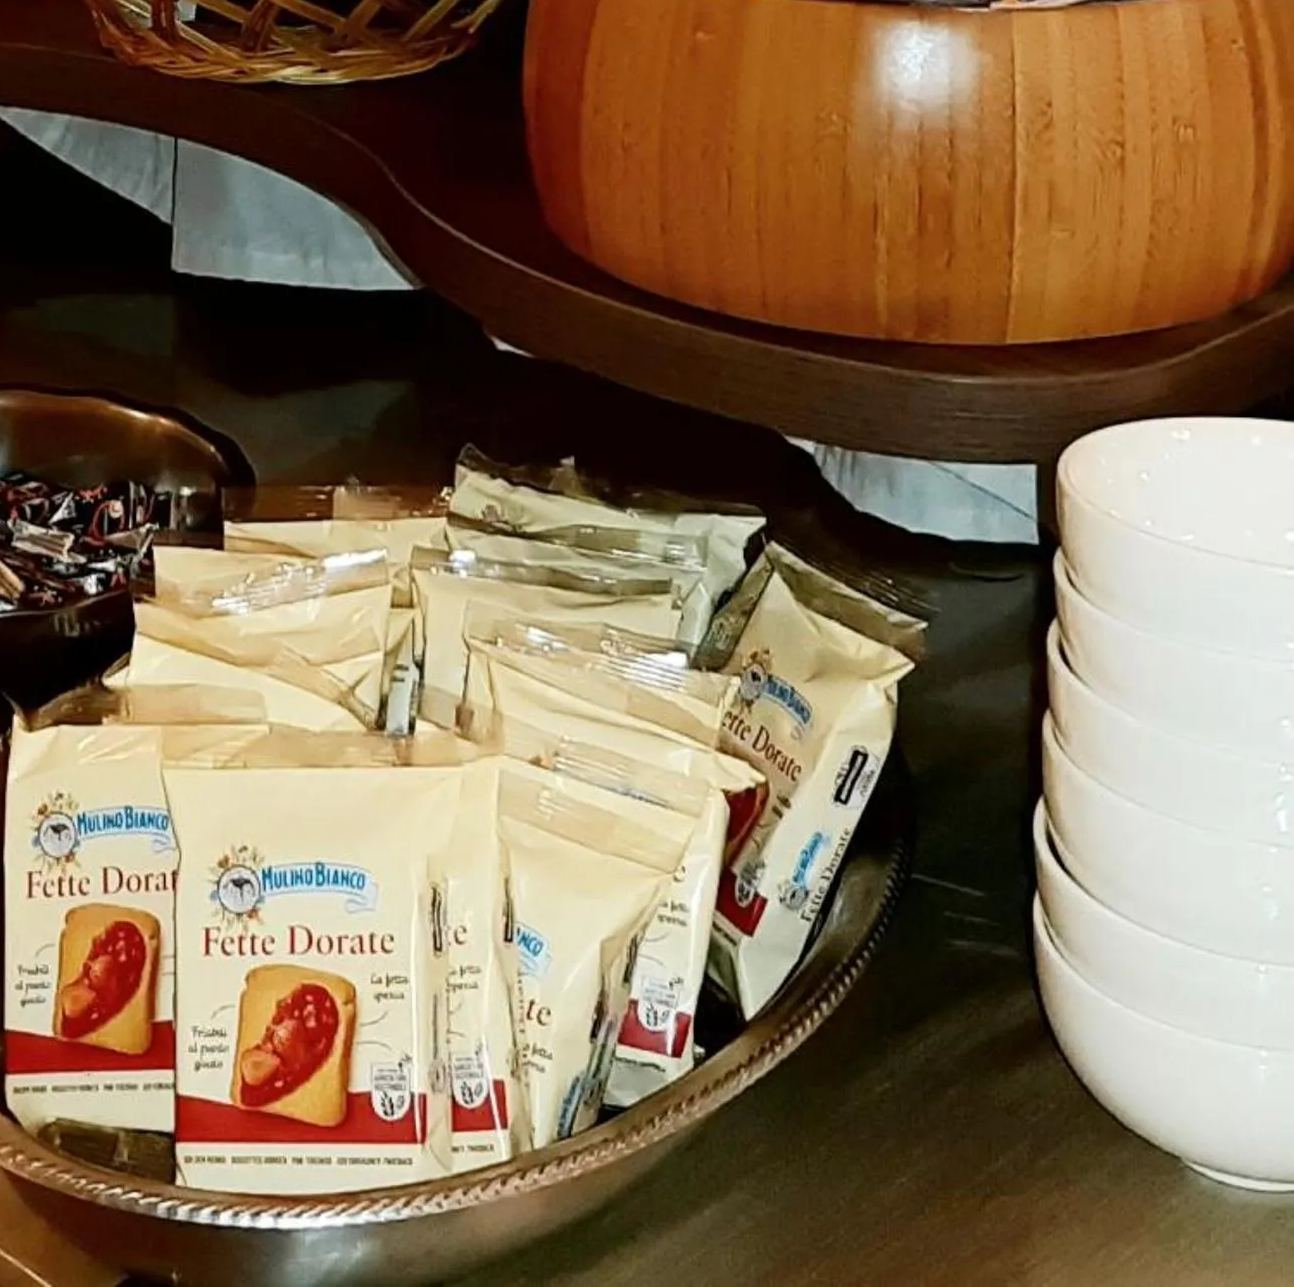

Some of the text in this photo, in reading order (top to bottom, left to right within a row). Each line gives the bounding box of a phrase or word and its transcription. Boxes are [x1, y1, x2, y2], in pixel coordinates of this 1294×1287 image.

[721, 710, 802, 782] ette Dorate
[26, 865, 180, 899] Fette Dorat
[202, 925, 395, 957] Fette Dorate
[517, 925, 544, 957] NCO
